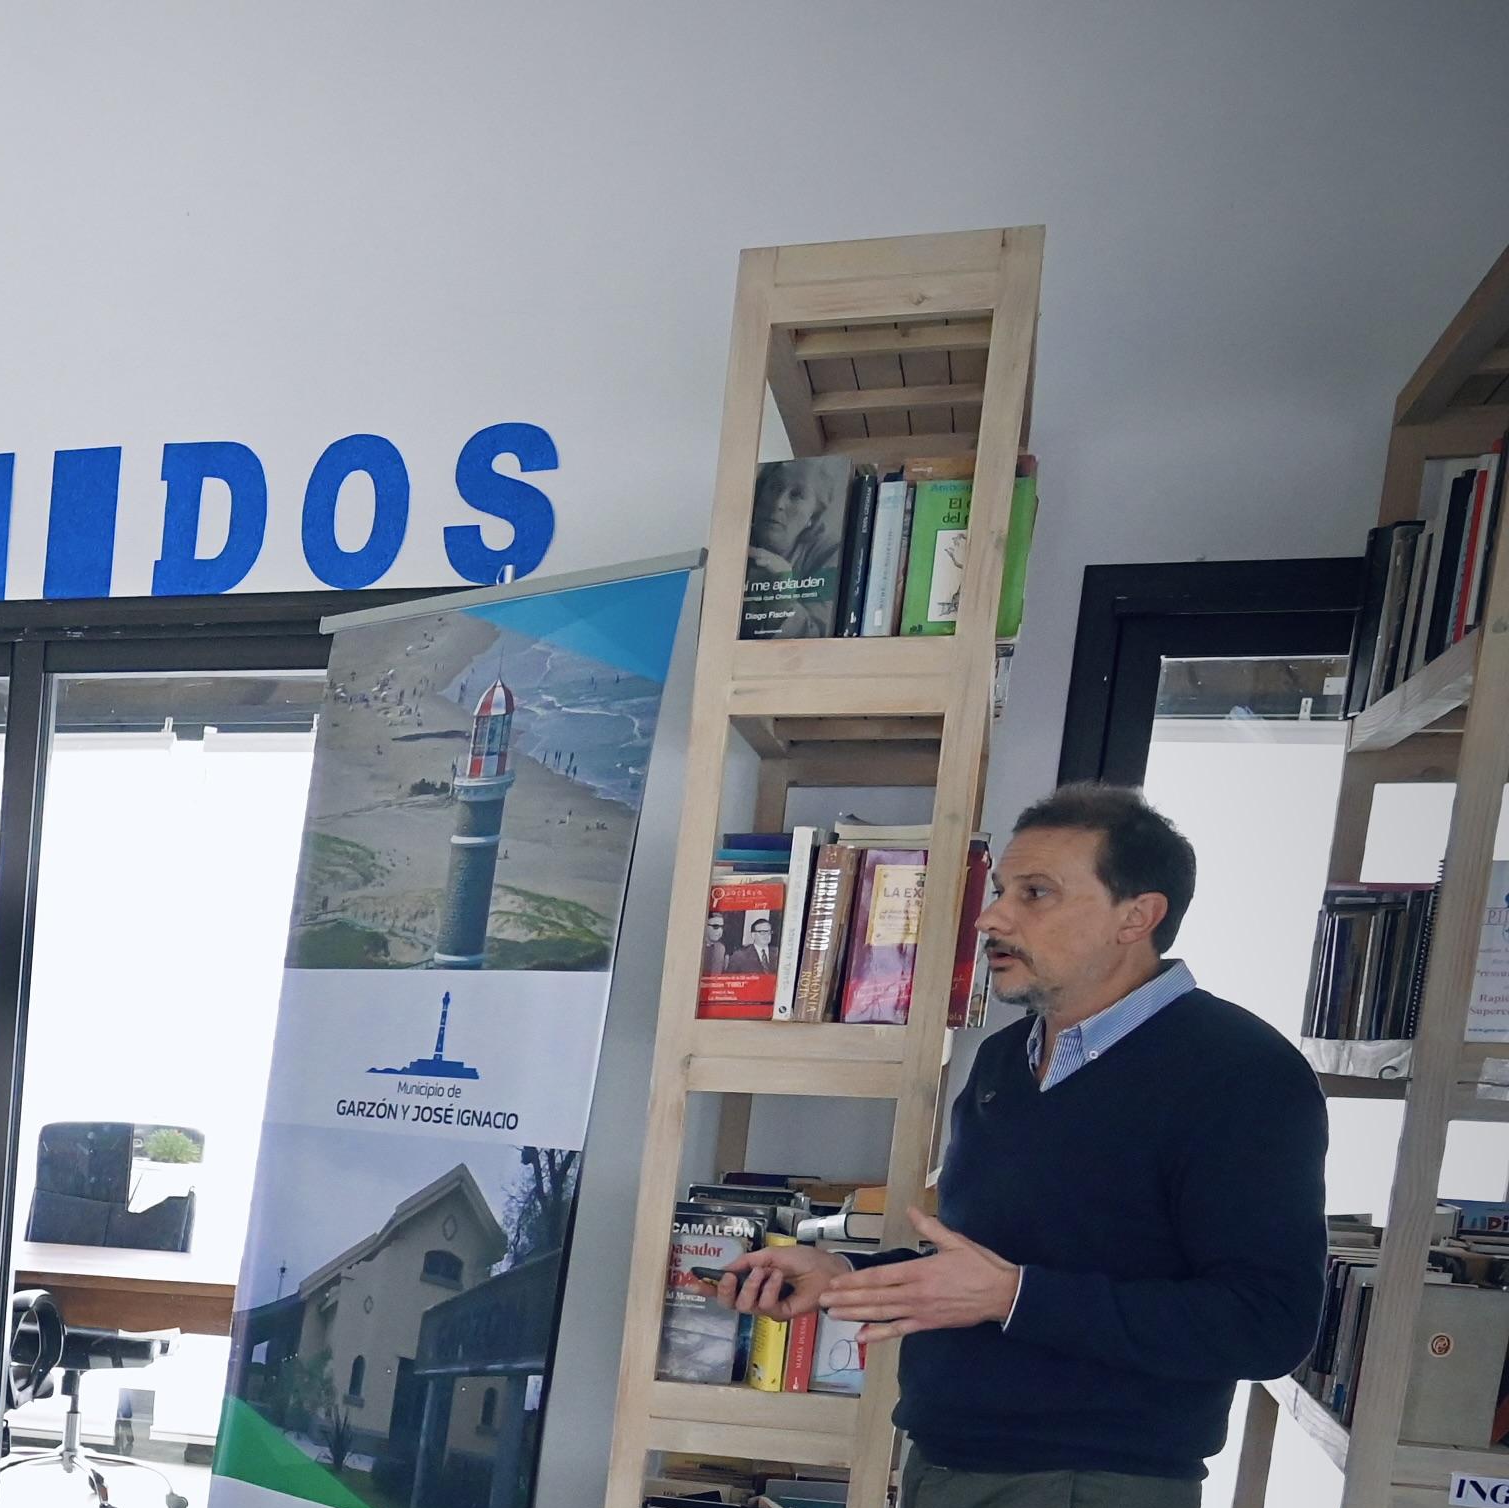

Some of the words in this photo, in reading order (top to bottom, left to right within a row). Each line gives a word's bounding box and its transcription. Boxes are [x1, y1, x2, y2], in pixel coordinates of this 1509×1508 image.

[751, 581, 770, 592] me
[773, 576, 825, 592] aplauden
[769, 610, 796, 619] Fischer
[810, 868, 840, 916] BARBARA
[397, 1080, 444, 1098] Municipio
[447, 1084, 461, 1099] de
[336, 1097, 399, 1120] GARZÓN
[401, 1103, 410, 1121] Y
[412, 1103, 455, 1125] JOSÉ
[457, 1109, 519, 1130] IGNACIO
